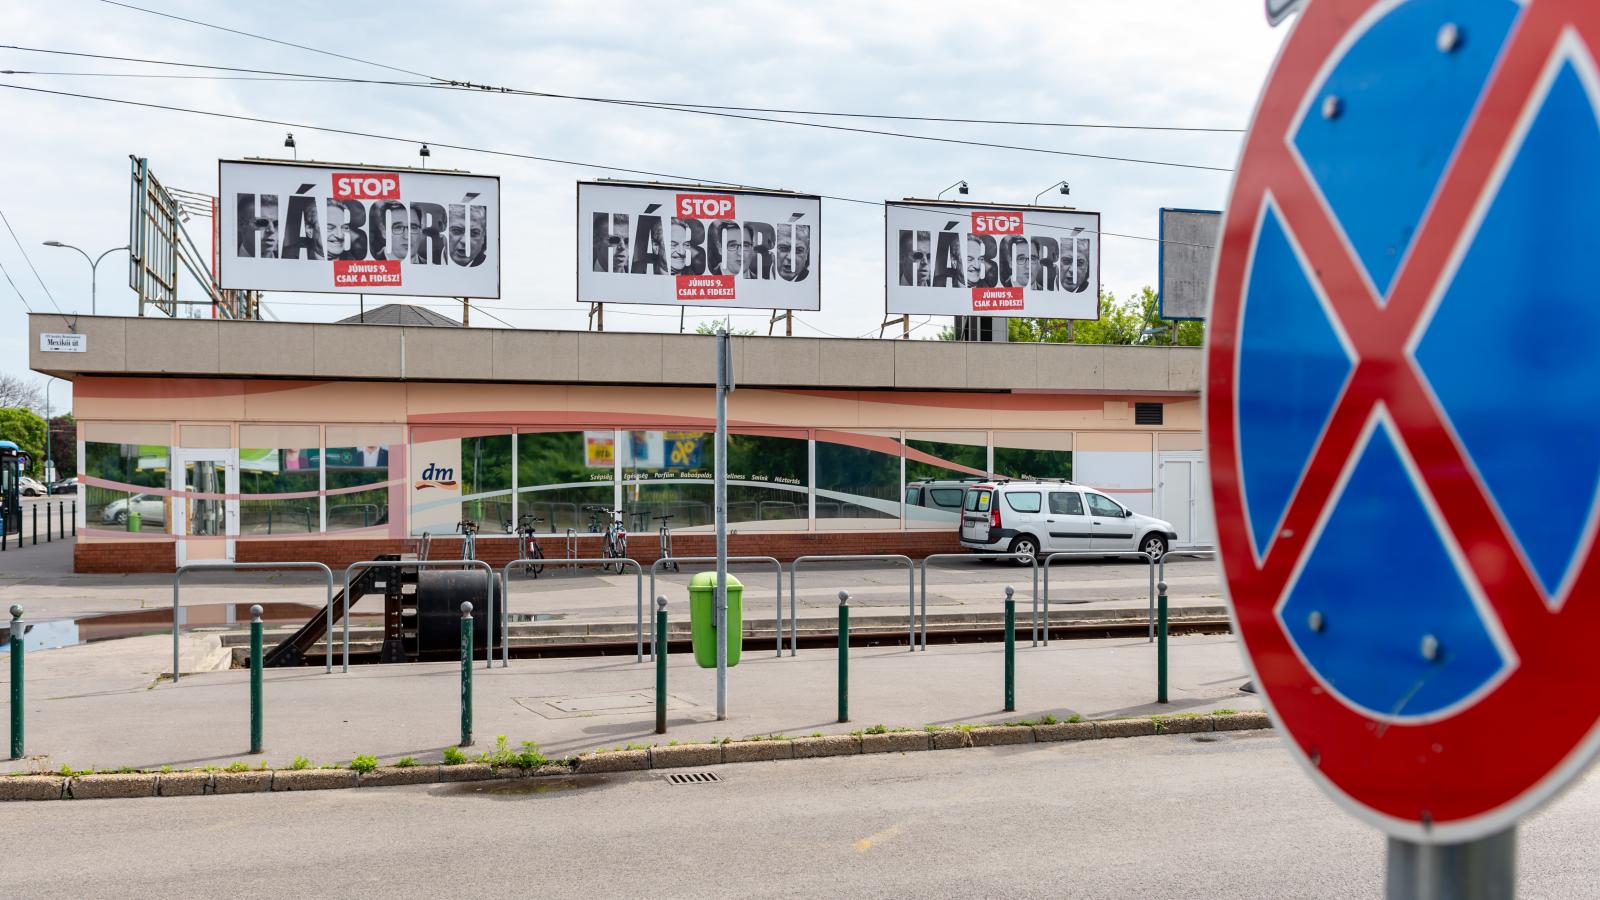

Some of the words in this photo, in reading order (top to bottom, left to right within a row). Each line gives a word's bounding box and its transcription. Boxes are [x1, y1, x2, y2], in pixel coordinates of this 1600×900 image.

[337, 177, 396, 196] STOP
[681, 198, 732, 216] STOP
[236, 183, 488, 268] HÁBORÚ
[976, 215, 1021, 232] STOP
[592, 203, 811, 283] HÁBORÚ
[898, 221, 1091, 294] HÁBORÚ
[347, 263, 378, 273] JÚNIUS
[380, 264, 388, 274] 9.
[336, 274, 358, 283] CSAK
[360, 274, 367, 283] A
[369, 274, 400, 283] FIDESZ!
[688, 277, 715, 287] JÚNIUS
[716, 279, 723, 288] 9.
[678, 288, 697, 296] CSAK
[699, 288, 705, 296] A
[707, 287, 734, 296] FIDESZ!
[982, 289, 1006, 299] JÚNIUS
[1006, 291, 1014, 299] 9.
[999, 299, 1023, 307] FIDESZ!
[421, 462, 454, 481] dm
[590, 473, 613, 481] Szépség
[654, 472, 675, 480] Parfüm
[680, 471, 712, 480] Babaápolás
[751, 473, 768, 481] Smink
[774, 475, 801, 484] Háztartás
